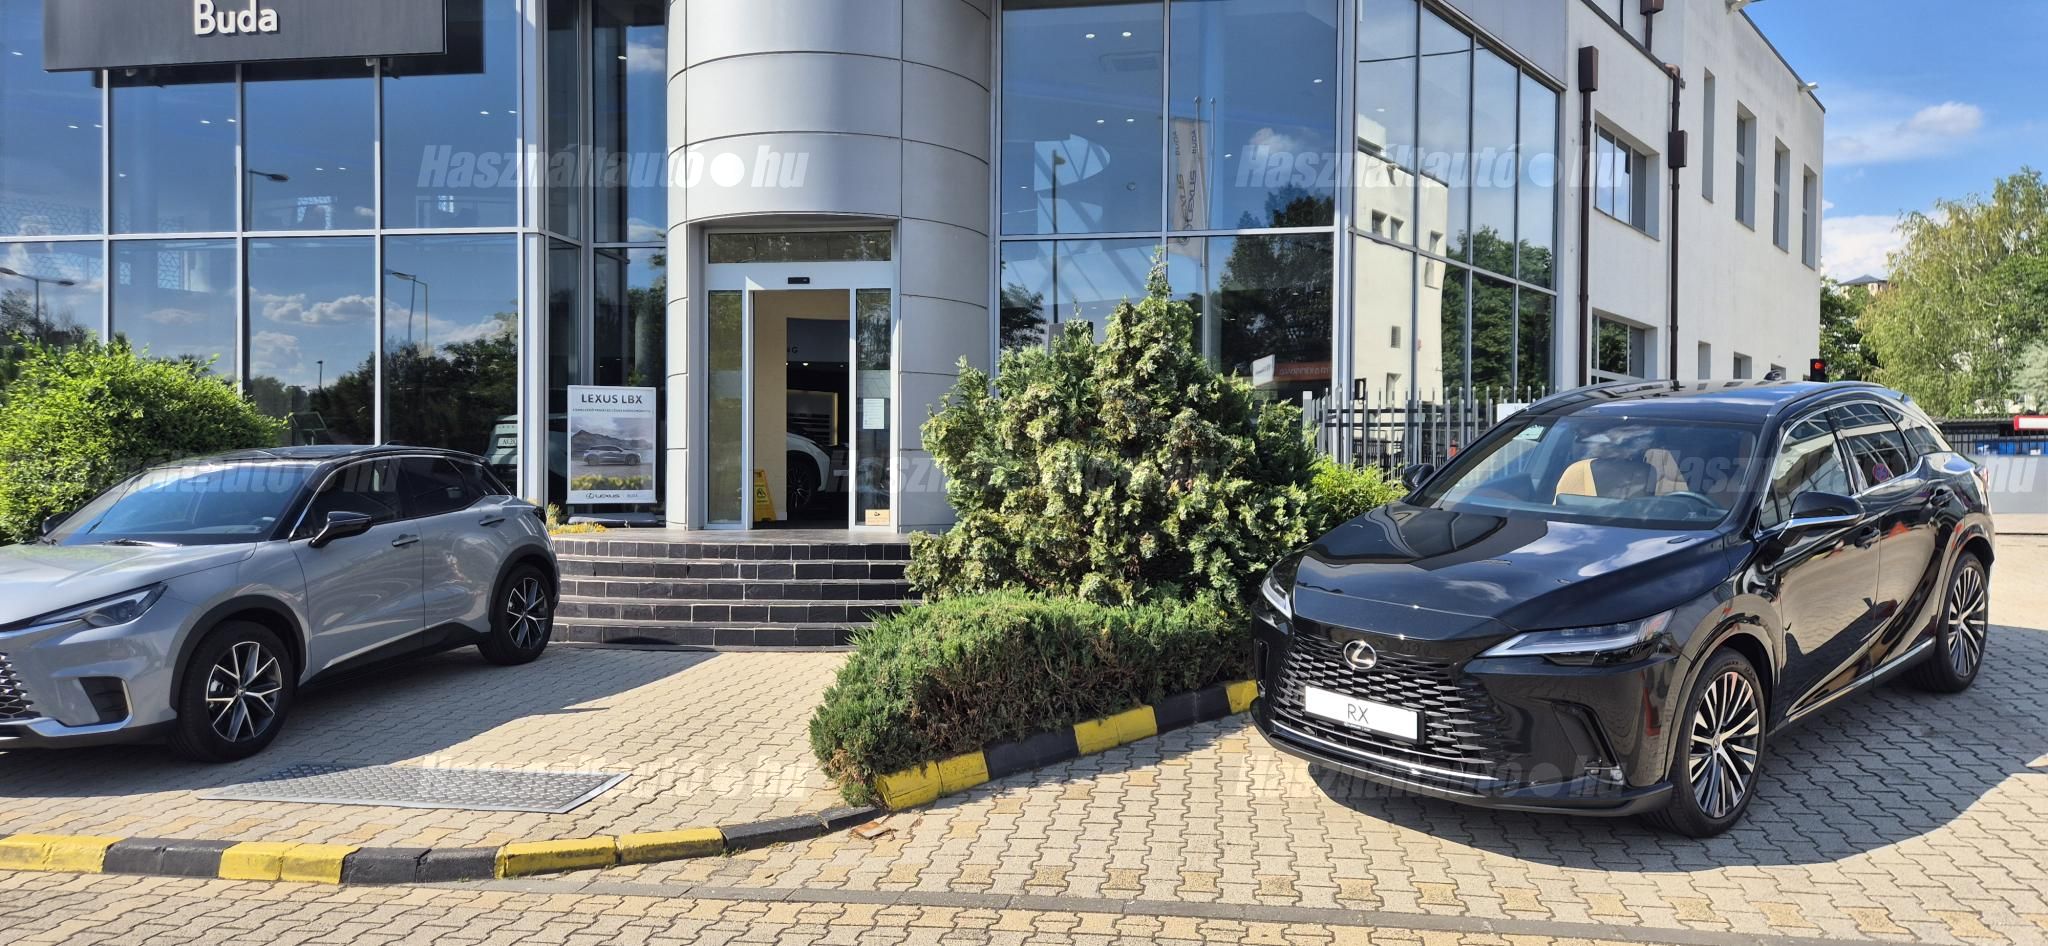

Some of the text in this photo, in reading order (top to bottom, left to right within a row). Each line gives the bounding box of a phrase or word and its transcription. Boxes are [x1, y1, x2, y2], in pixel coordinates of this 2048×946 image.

[193, 0, 278, 35] Buda
[581, 393, 643, 405] LEXUS LBX
[1347, 703, 1369, 725] RX
